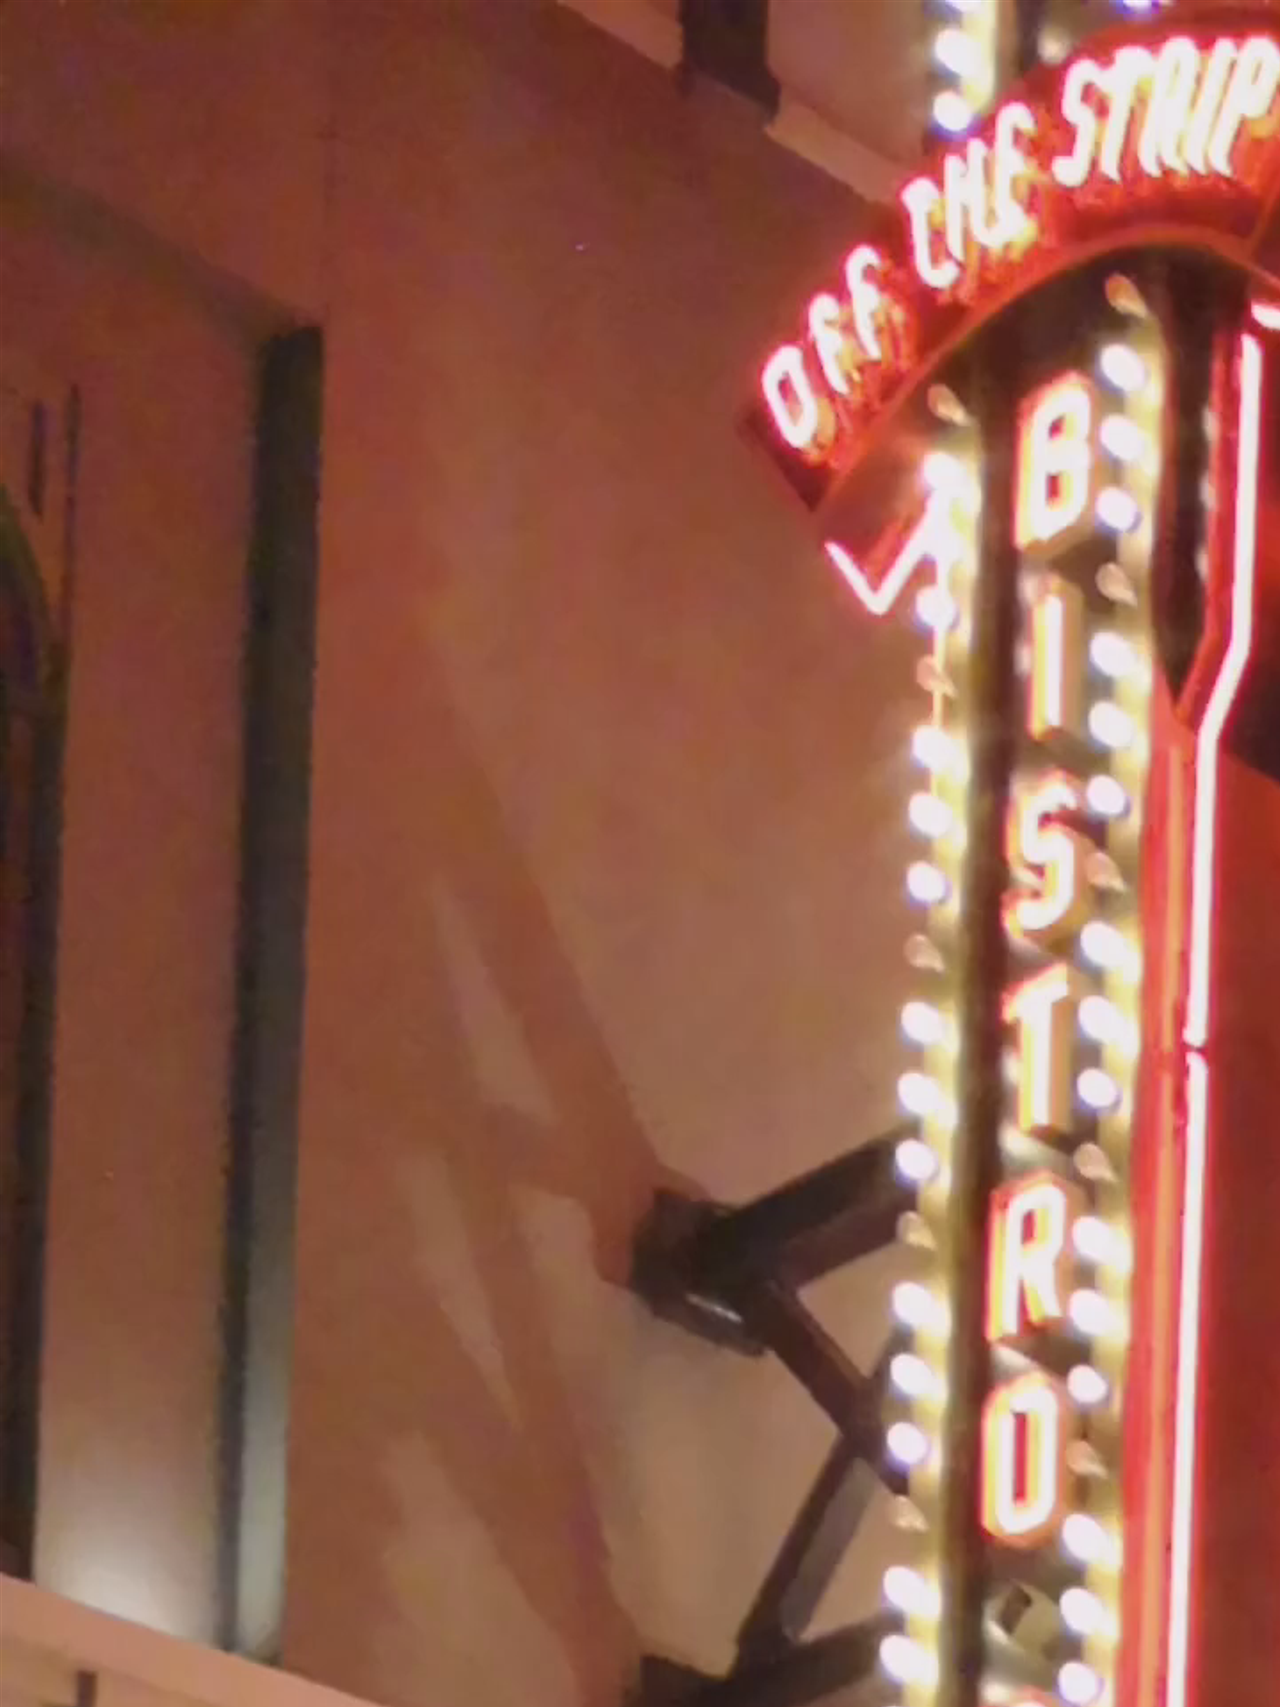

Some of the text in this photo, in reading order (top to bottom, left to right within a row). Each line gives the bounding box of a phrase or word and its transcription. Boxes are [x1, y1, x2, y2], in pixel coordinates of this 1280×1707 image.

[761, 244, 888, 450] OFF
[901, 101, 1037, 290] THE
[979, 371, 1093, 1548] BISTRO
